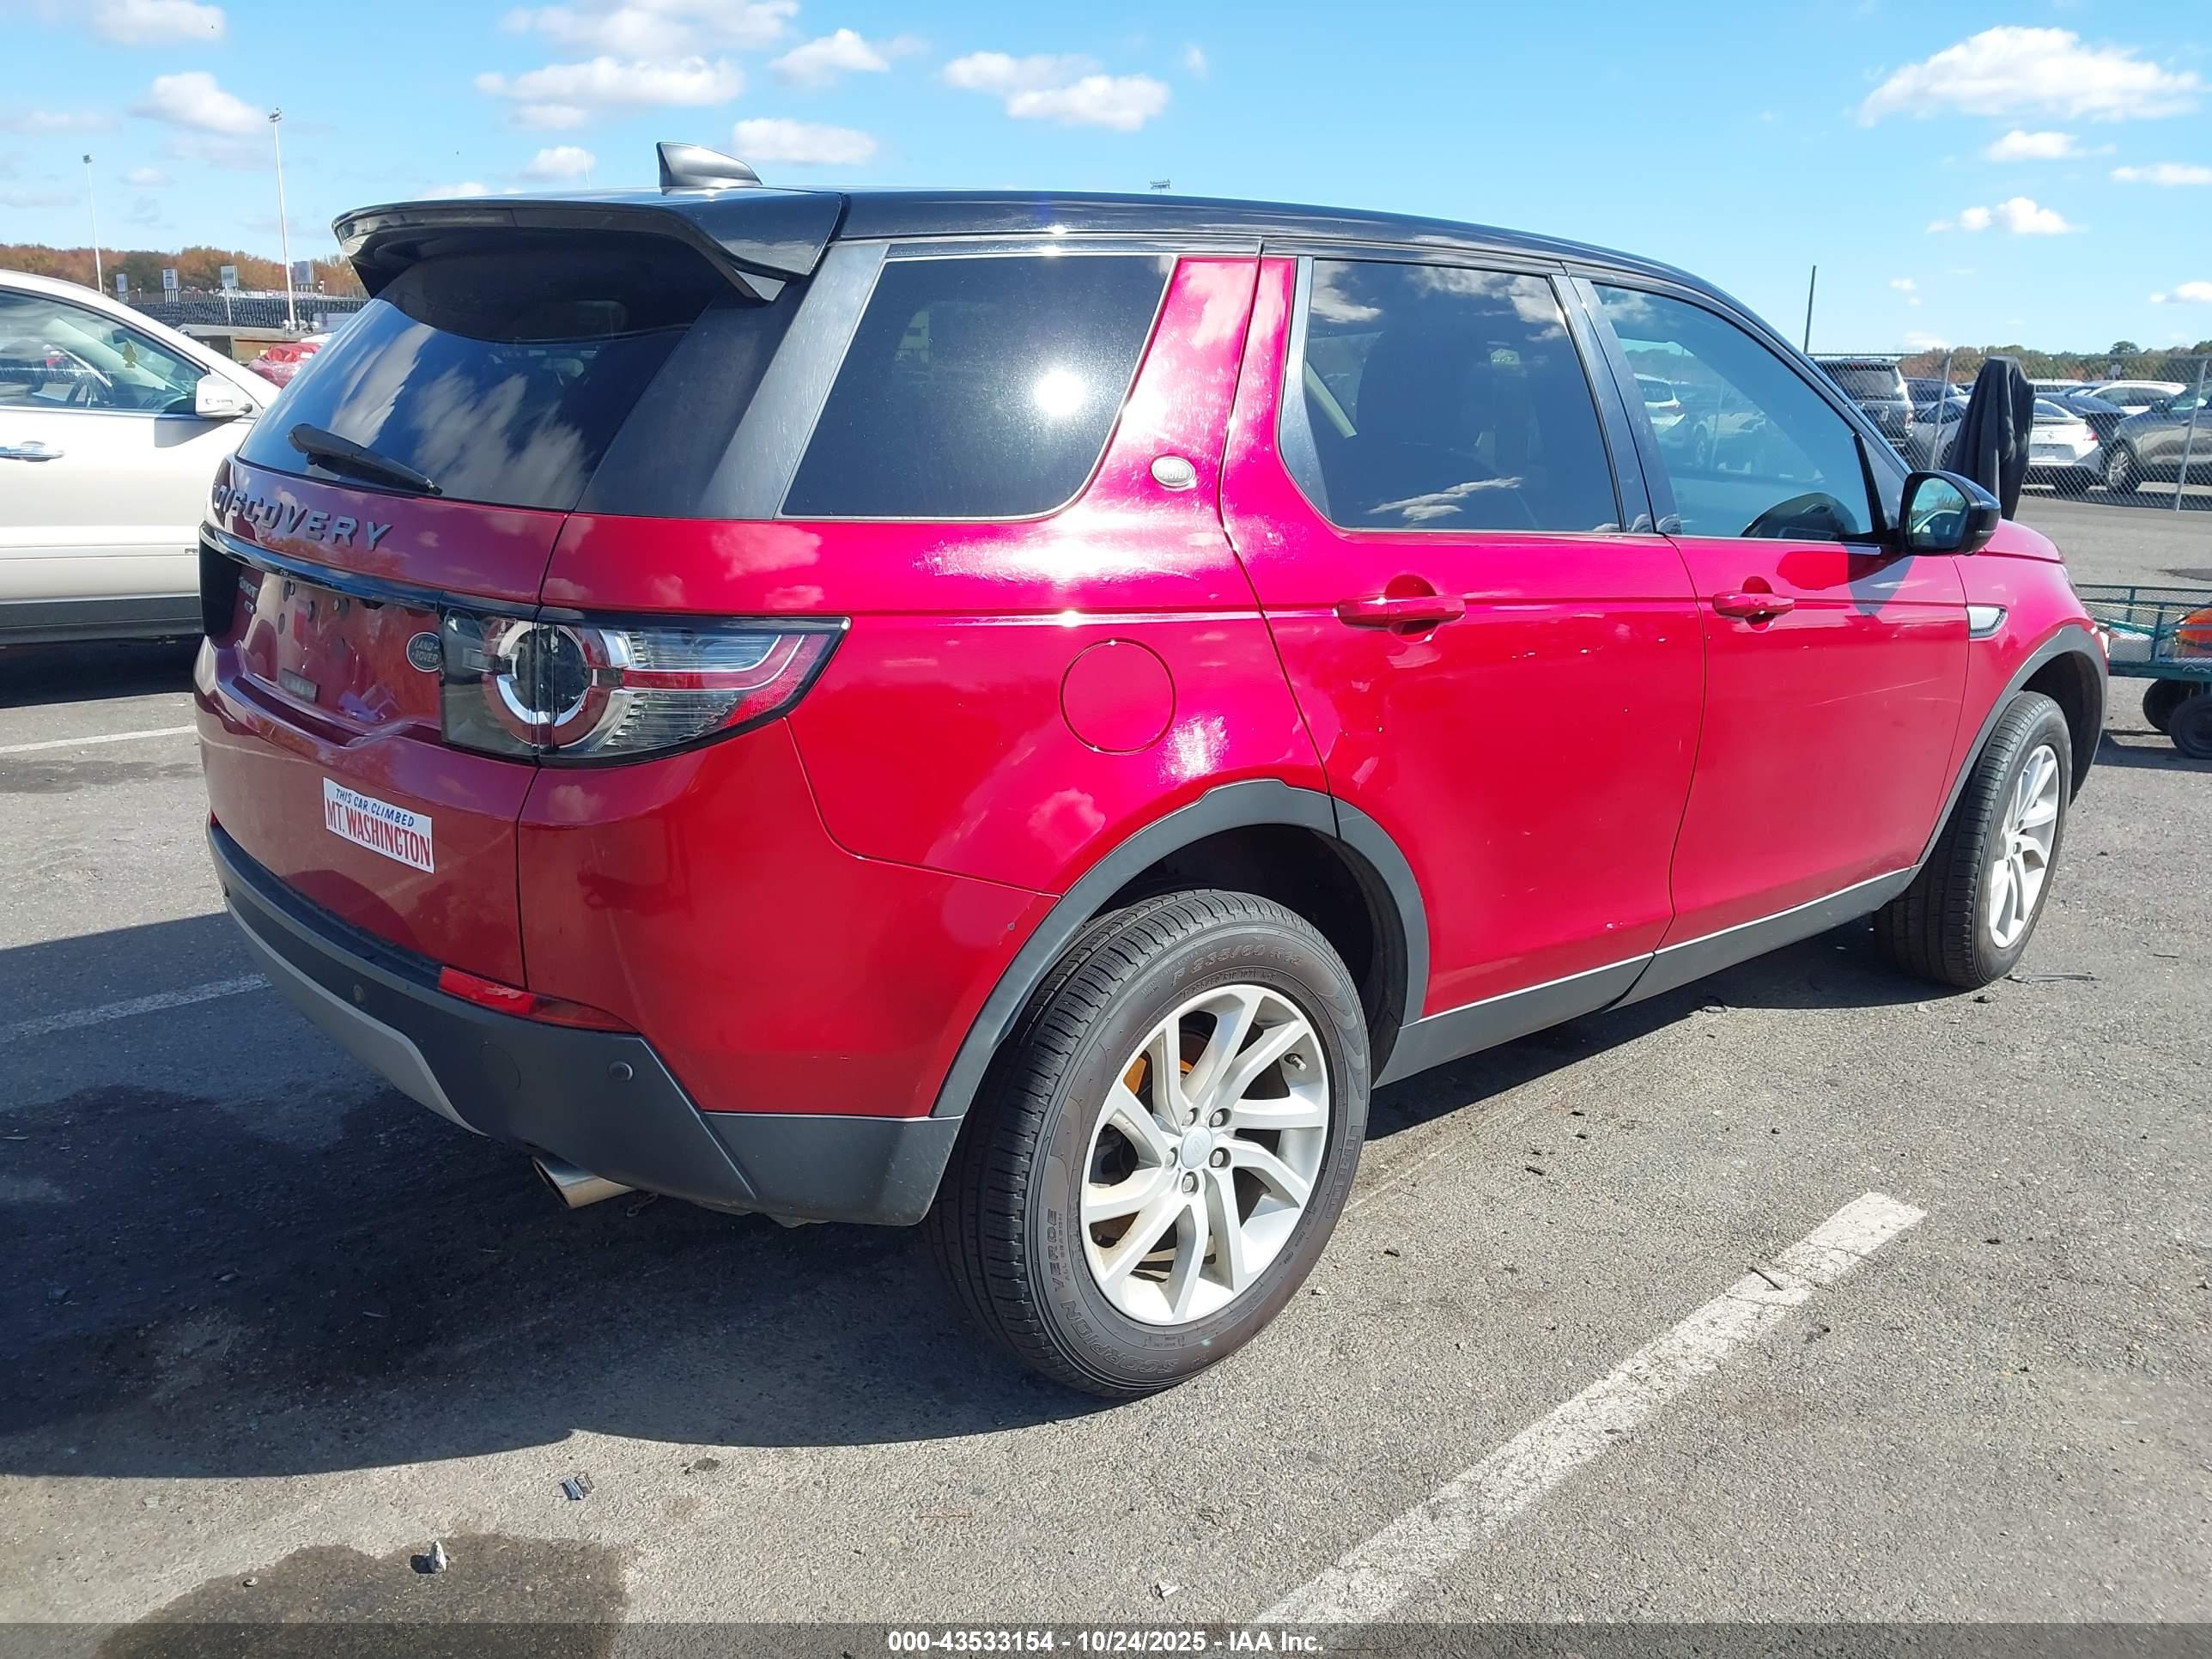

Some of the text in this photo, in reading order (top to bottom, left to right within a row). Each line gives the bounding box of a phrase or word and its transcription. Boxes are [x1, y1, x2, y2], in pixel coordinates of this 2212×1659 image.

[214, 485, 393, 550] DISCOVERY
[326, 798, 430, 866] MT. WASHINGTON
[336, 788, 414, 827] THIS CAR CLIMBED
[1044, 1206, 1066, 1292] VERDE
[1060, 1297, 1179, 1372] SCORPION
